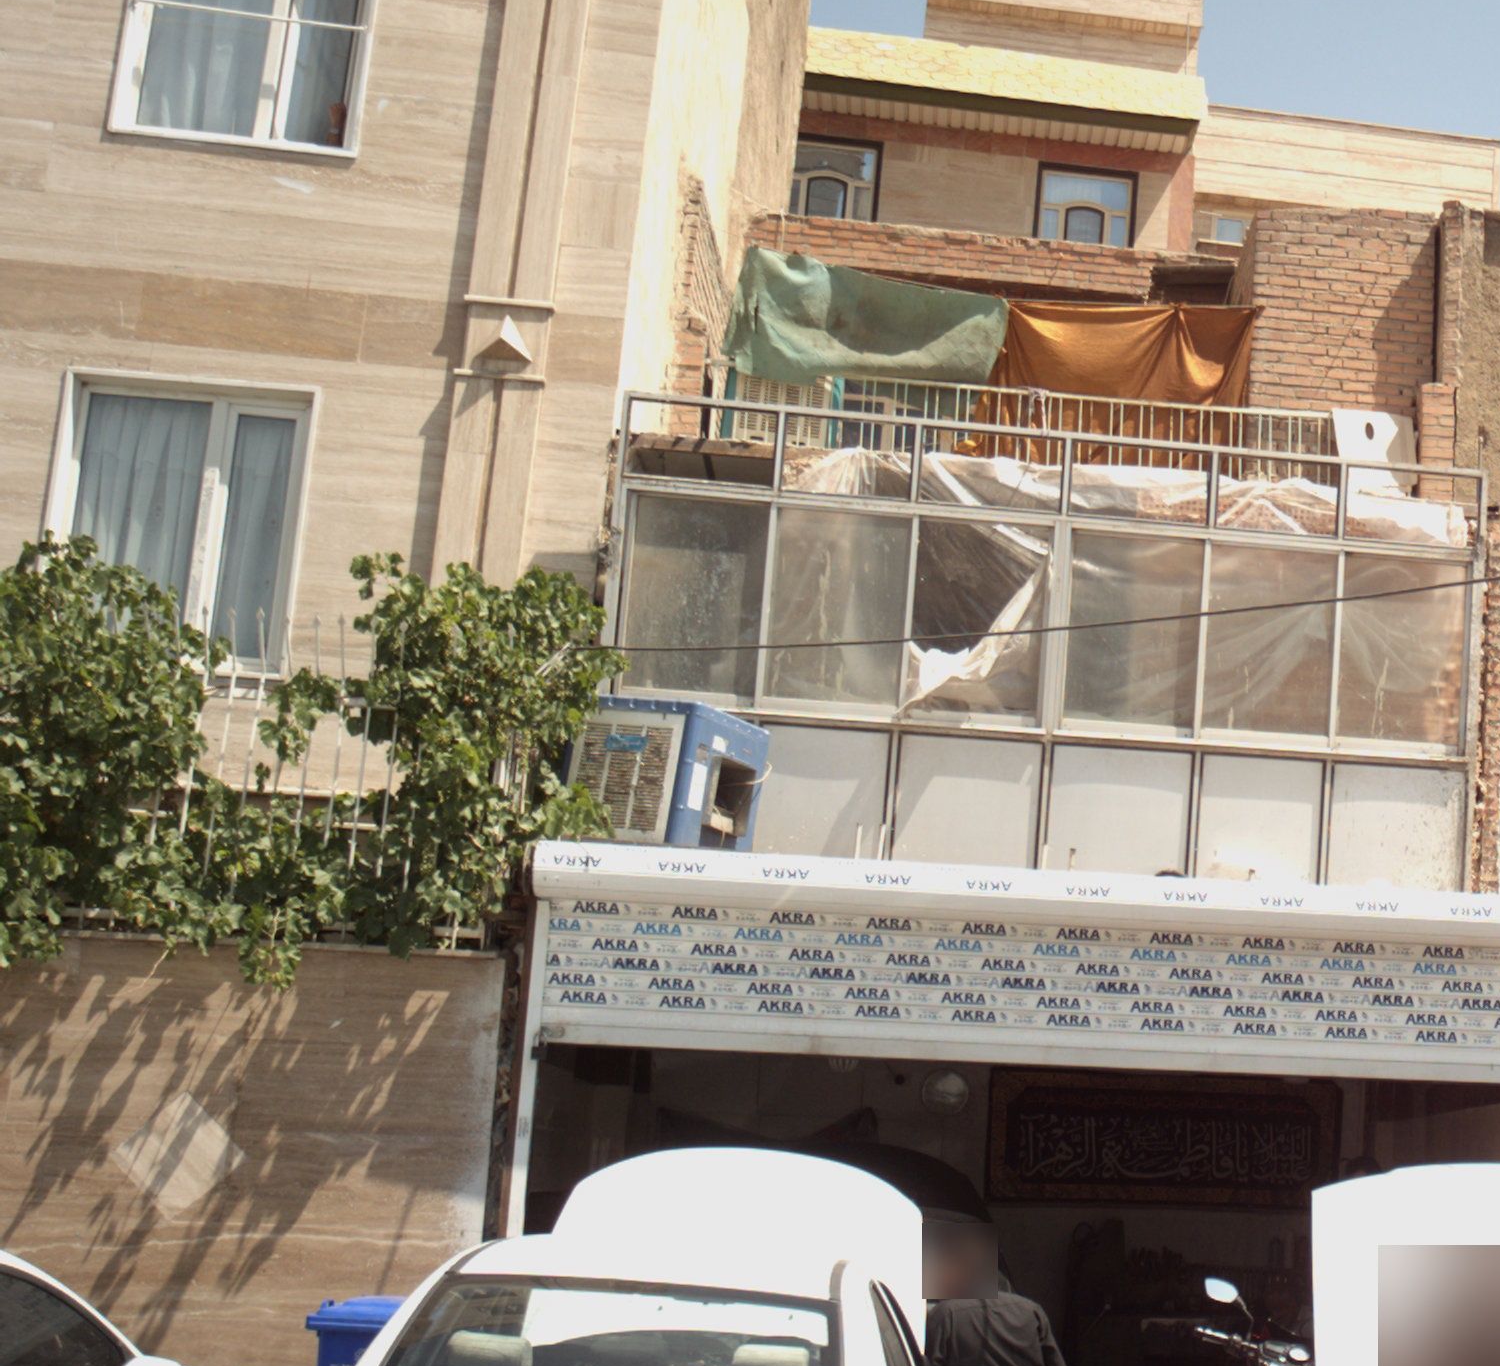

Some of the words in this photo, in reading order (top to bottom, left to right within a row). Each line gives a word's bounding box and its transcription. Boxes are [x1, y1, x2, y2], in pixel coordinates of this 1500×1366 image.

[554, 856, 602, 868] AKRA
[658, 861, 706, 874] AKRA
[762, 868, 810, 880] AKRA
[865, 873, 912, 885] AKRA
[966, 879, 1012, 892] AKRA
[1066, 886, 1110, 897] AKRA
[1163, 892, 1207, 902] AKRA
[1260, 897, 1304, 907] AKRA
[1356, 901, 1399, 913] AKRA
[1450, 907, 1492, 917] AKRA
[549, 918, 581, 931] KRA
[632, 922, 682, 935] AKRA
[734, 927, 783, 941] AKRA
[834, 933, 884, 947] AKRA
[934, 938, 983, 952] AKRA
[1032, 943, 1080, 957] AKRA
[1129, 948, 1177, 962] AKRA
[1226, 953, 1272, 967] AKRA
[1320, 958, 1365, 972] AKRA
[1412, 962, 1457, 975] AKRA
[572, 900, 620, 916] AKRA
[671, 906, 718, 920] AKRA
[769, 911, 815, 925] AKRA
[866, 917, 911, 932] AKRA
[962, 921, 1006, 936] AKRA
[1056, 927, 1100, 941] AKRA
[1150, 932, 1193, 946] AKRA
[1242, 937, 1285, 950] AKRA
[1332, 941, 1375, 955] AKRA
[1422, 945, 1464, 959] AKRA
[591, 938, 638, 952] AKRA
[690, 943, 737, 957] AKRA
[788, 948, 834, 962] AKRA
[885, 953, 930, 967] AKRA
[981, 958, 1026, 972] AKRA
[1075, 963, 1120, 977] AKRA
[1168, 967, 1213, 981] AKRA
[1261, 972, 1304, 985] AKRA
[1352, 976, 1394, 990] AKRA
[1441, 980, 1483, 994] AKRA
[613, 957, 660, 971] AKRA
[712, 962, 758, 976] AKRA
[809, 967, 855, 981] AKRA
[906, 972, 952, 985] AKRA
[1001, 977, 1046, 991] AKRA
[1095, 982, 1140, 995] AKRA
[1189, 986, 1233, 999] AKRA
[1281, 990, 1324, 1004] AKRA
[1371, 994, 1414, 1008] AKRA
[549, 972, 595, 986] AKRA
[648, 977, 695, 991] AKRA
[747, 982, 793, 996] AKRA
[844, 987, 890, 1000] AKRA
[941, 992, 986, 1005] AKRA
[1036, 996, 1081, 1010] AKRA
[1130, 1001, 1174, 1014] AKRA
[1223, 1005, 1266, 1018] AKRA
[1314, 1009, 1358, 1022] AKRA
[1405, 1013, 1447, 1027] AKRA
[560, 990, 607, 1005] AKRA
[659, 996, 706, 1009] AKRA
[757, 1000, 804, 1014] AKRA
[854, 1005, 900, 1019] AKRA
[951, 1010, 996, 1023] AKRA
[1046, 1014, 1091, 1027] AKRA
[1140, 1019, 1184, 1031] AKRA
[1233, 1022, 1276, 1035] AKRA
[1324, 1027, 1368, 1040] AKRA
[1415, 1030, 1457, 1043] AKRA
